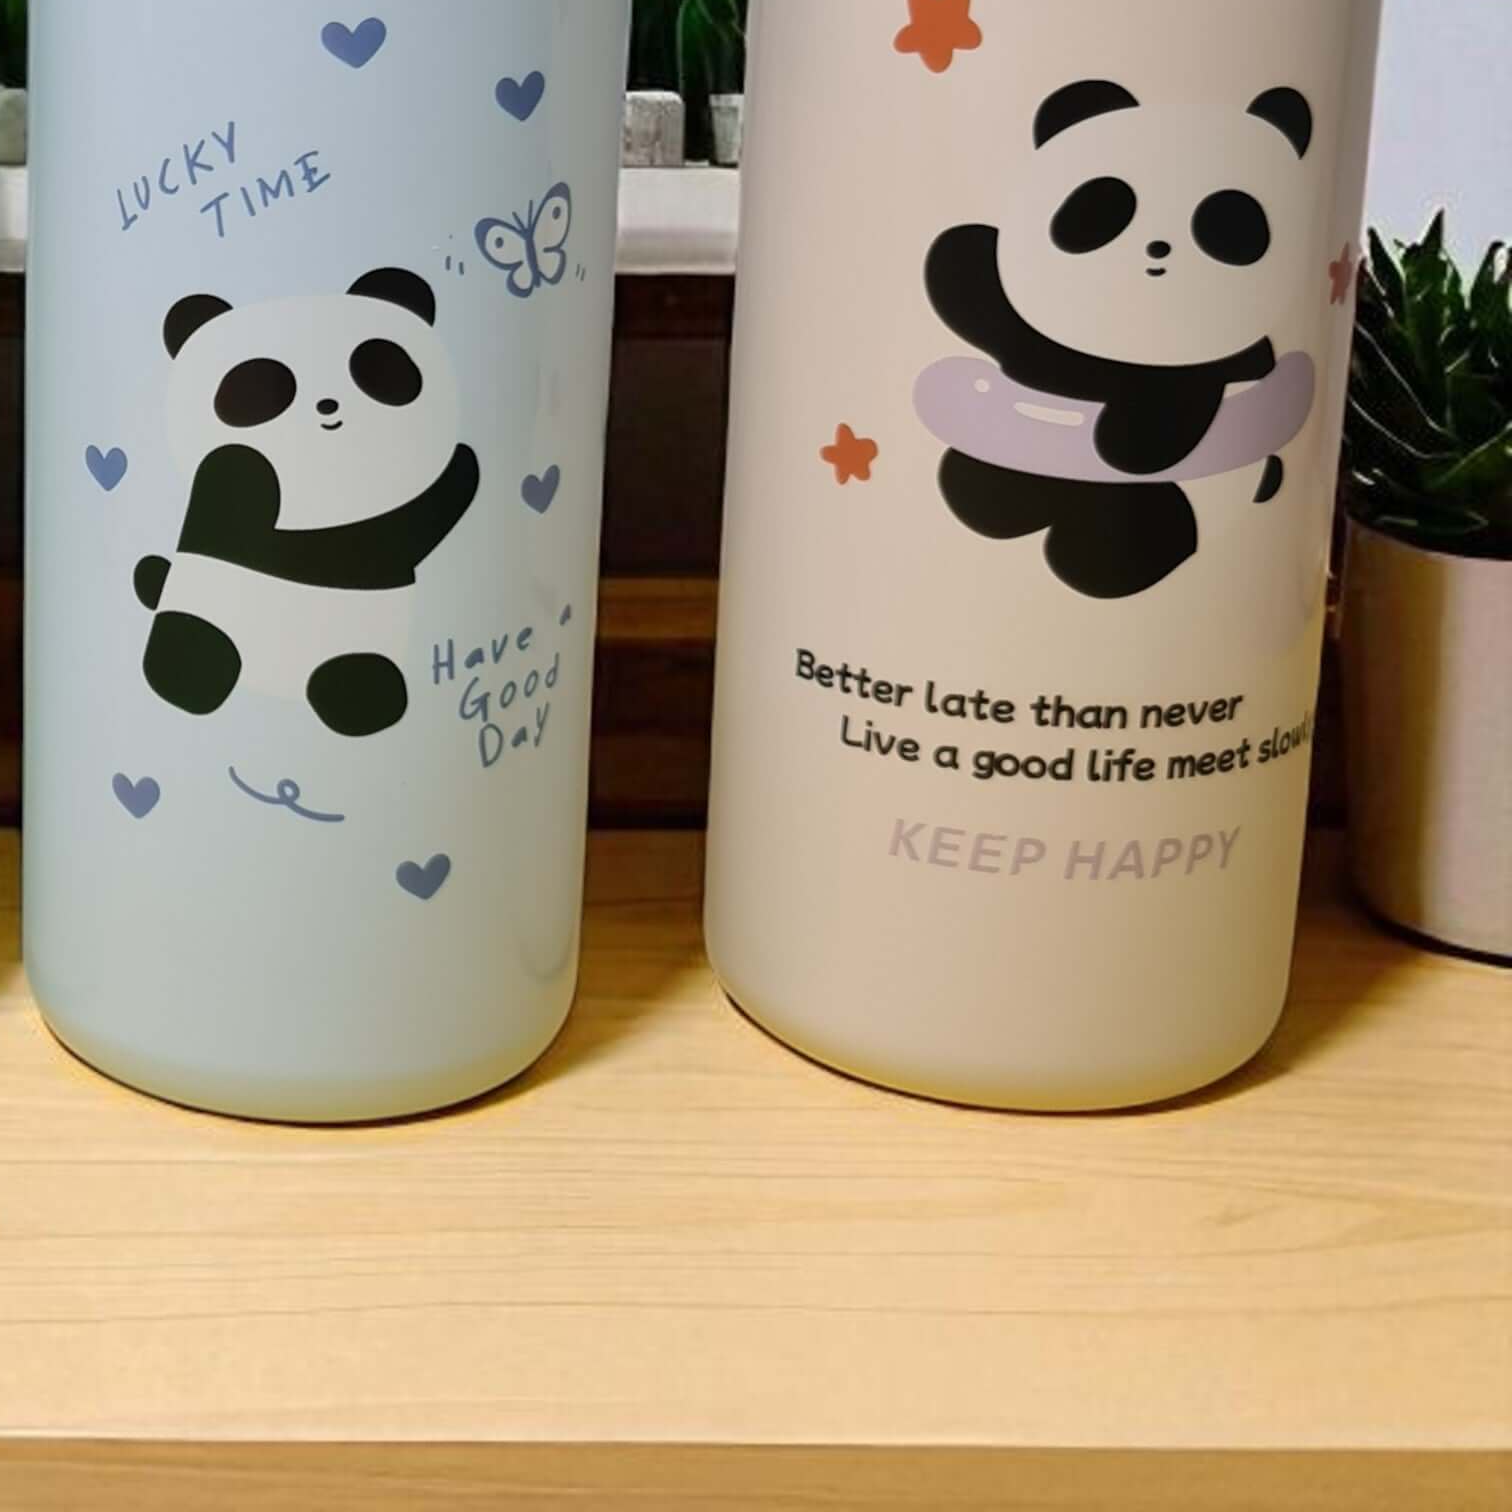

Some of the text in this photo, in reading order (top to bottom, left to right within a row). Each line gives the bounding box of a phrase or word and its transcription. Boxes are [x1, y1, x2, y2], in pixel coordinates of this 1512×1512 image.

[116, 121, 235, 231] LUCKY
[200, 150, 331, 238] TIME
[432, 626, 533, 685] Have
[459, 652, 560, 723] Good
[795, 647, 1244, 729] Better late than never
[478, 701, 550, 768] Day
[839, 714, 920, 763] Live
[933, 745, 960, 770] a
[972, 748, 1076, 780] good
[1087, 748, 1155, 782] life
[1167, 738, 1251, 780] meet
[888, 818, 1242, 881] KEEP HAPPY
